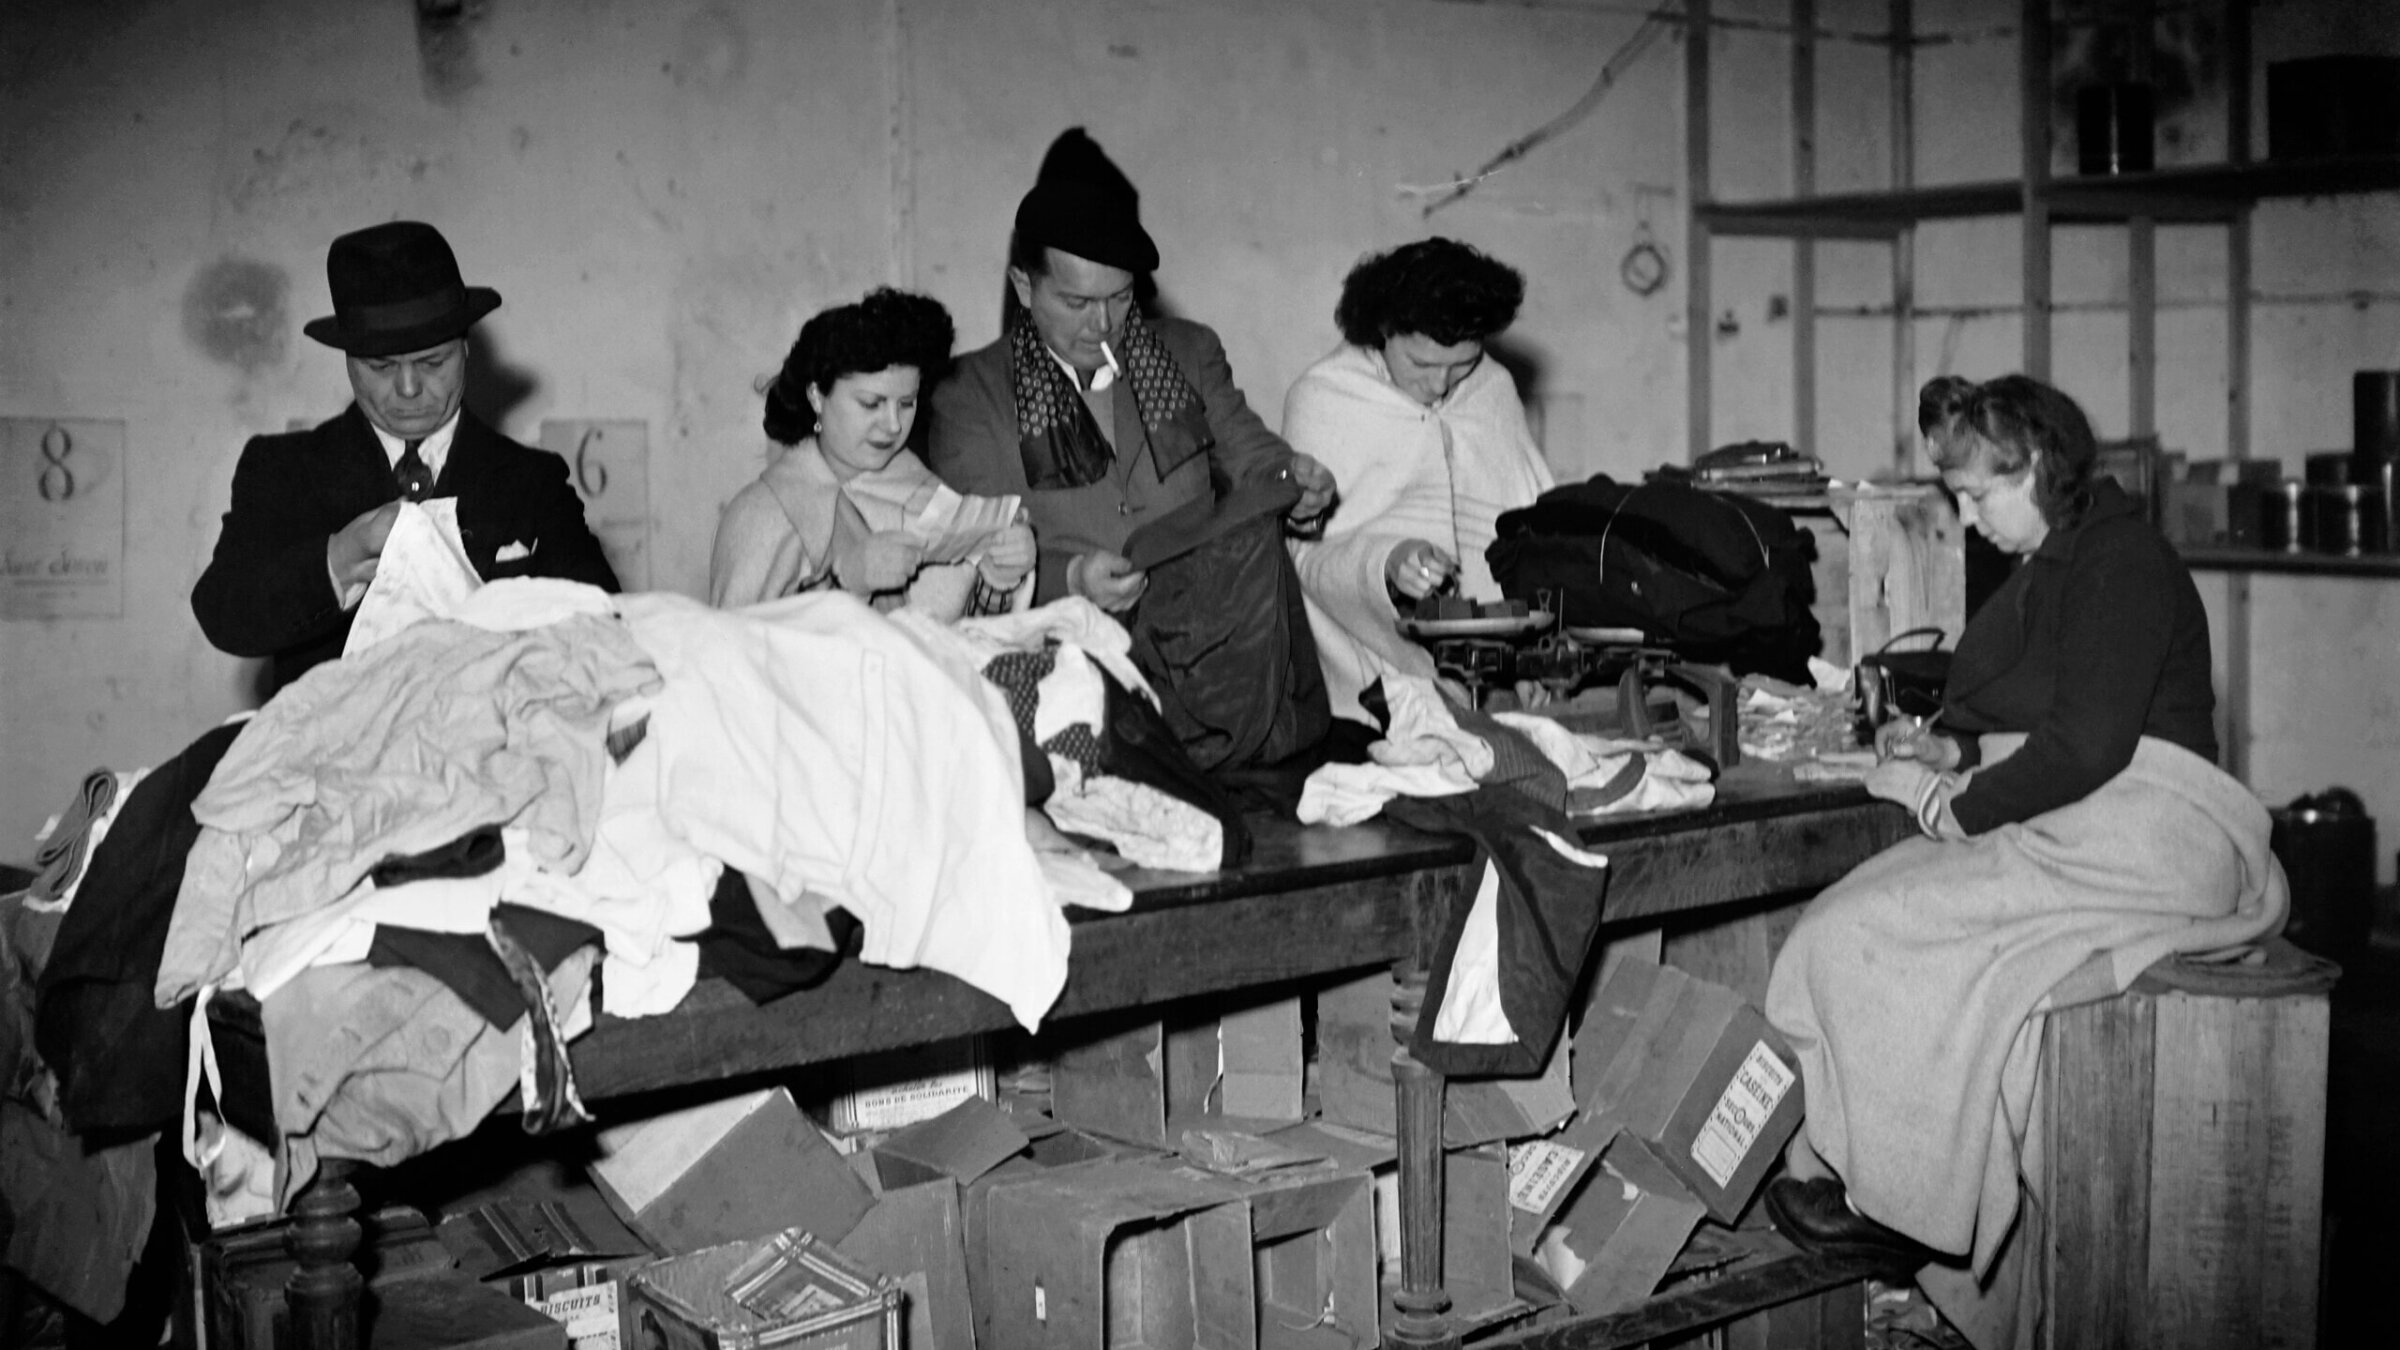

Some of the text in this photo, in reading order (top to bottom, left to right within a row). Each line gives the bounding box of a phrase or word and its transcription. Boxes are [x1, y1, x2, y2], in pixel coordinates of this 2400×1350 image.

[38, 420, 74, 501] 8
[576, 426, 607, 498] 6
[865, 1097, 891, 1108] BONS
[894, 1095, 907, 1104] DE
[1716, 1112, 1746, 1146] NATIONAL
